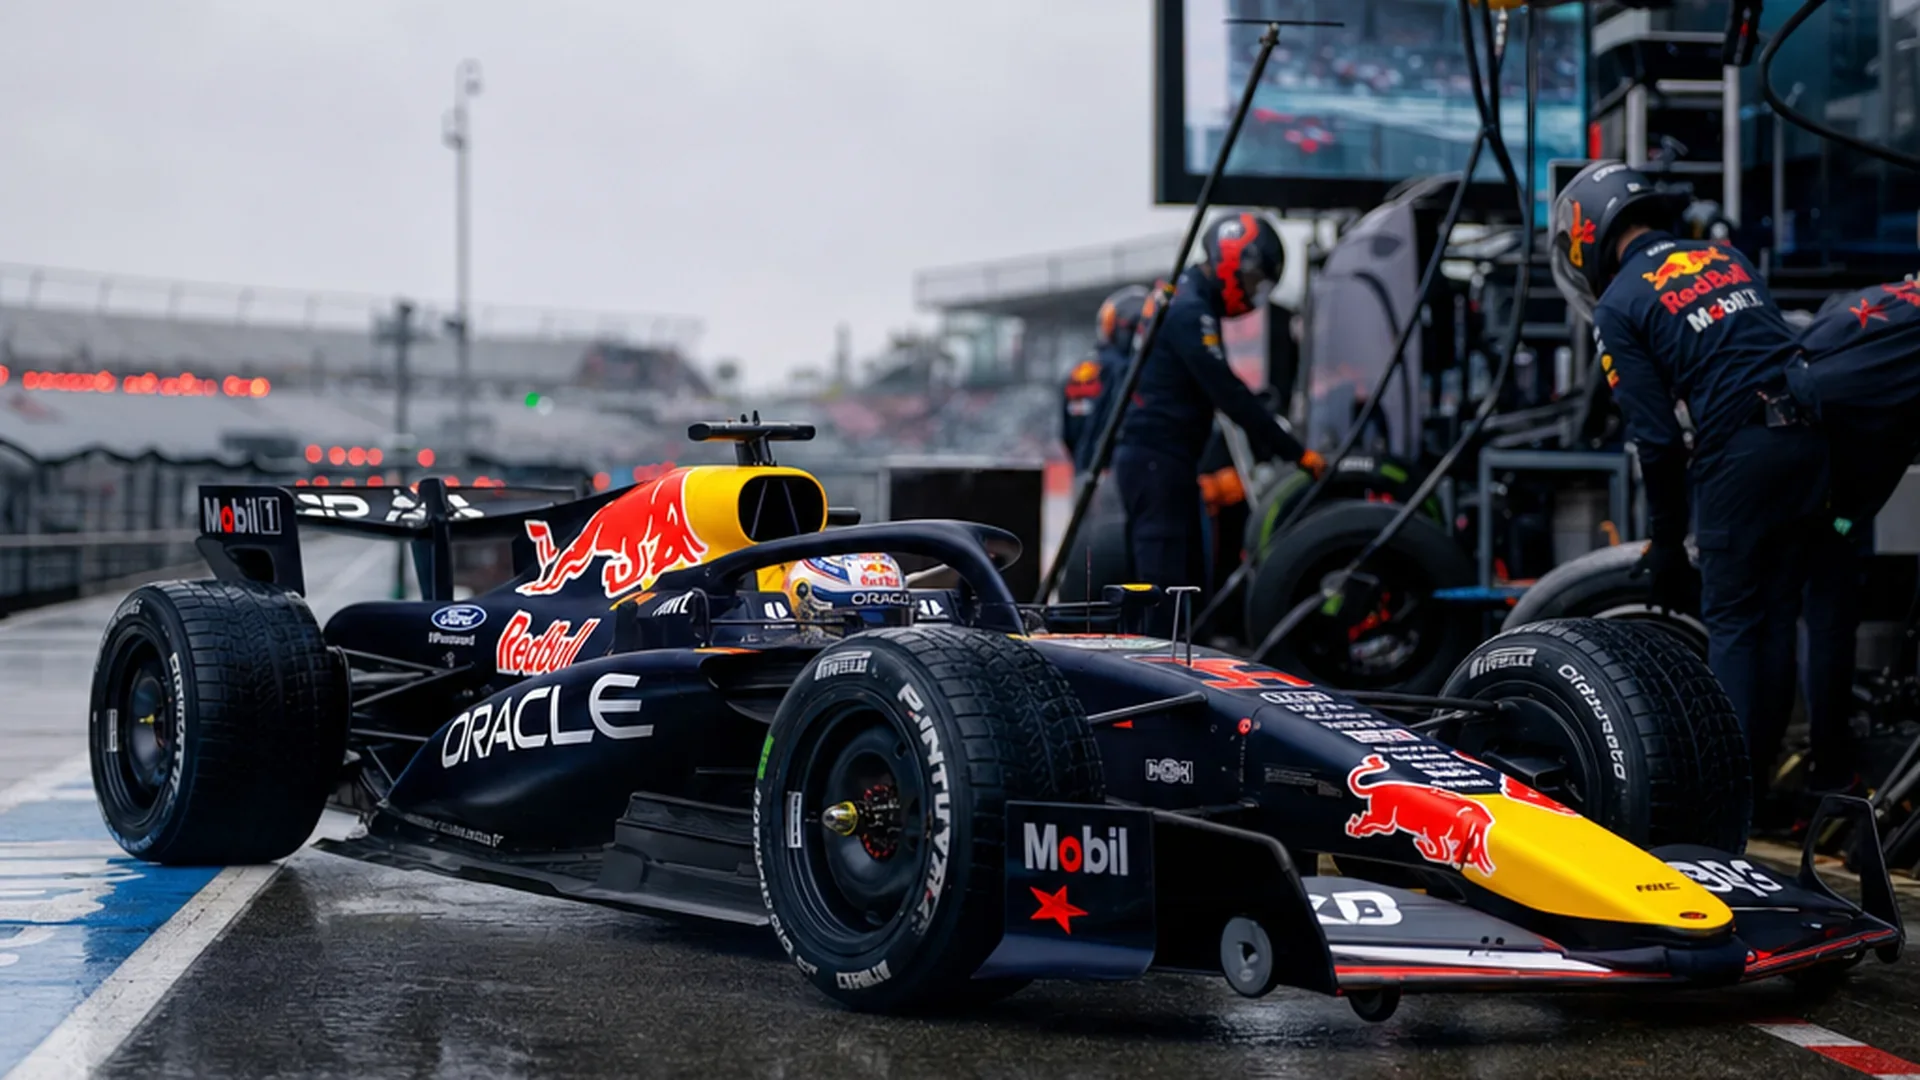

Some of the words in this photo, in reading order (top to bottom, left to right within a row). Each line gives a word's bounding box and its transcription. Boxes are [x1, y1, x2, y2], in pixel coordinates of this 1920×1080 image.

[203, 496, 259, 534] Mobil
[441, 673, 654, 768] ORACLE
[1023, 822, 1129, 876] Mobil
